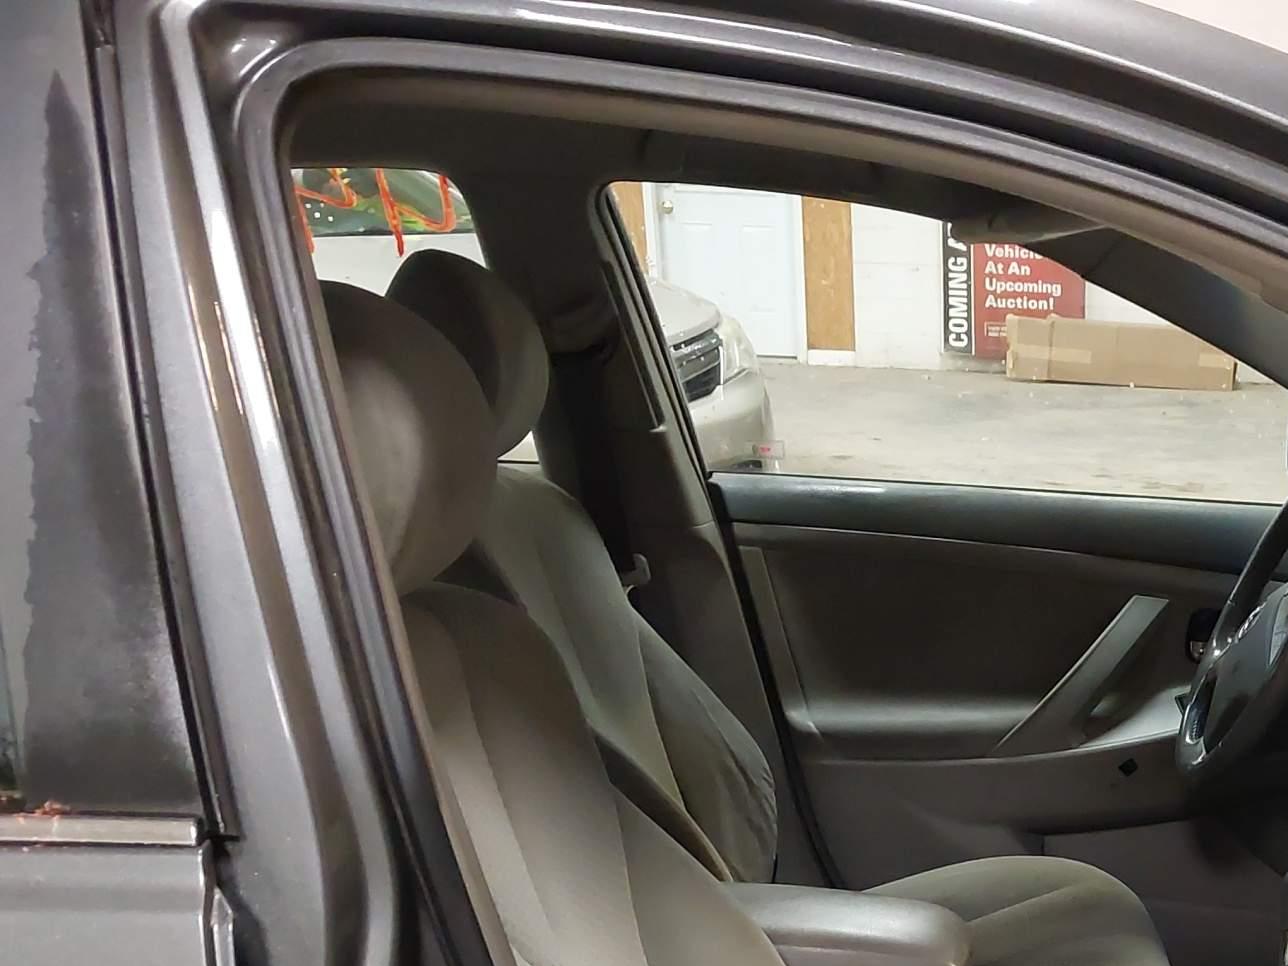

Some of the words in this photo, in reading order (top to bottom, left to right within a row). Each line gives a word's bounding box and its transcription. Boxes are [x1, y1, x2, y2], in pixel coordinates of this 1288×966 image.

[985, 261, 1004, 275] At
[1007, 261, 1031, 276] An
[984, 277, 1062, 297] Upcoming
[948, 256, 969, 348] COMING
[984, 295, 1055, 311] Auction!
